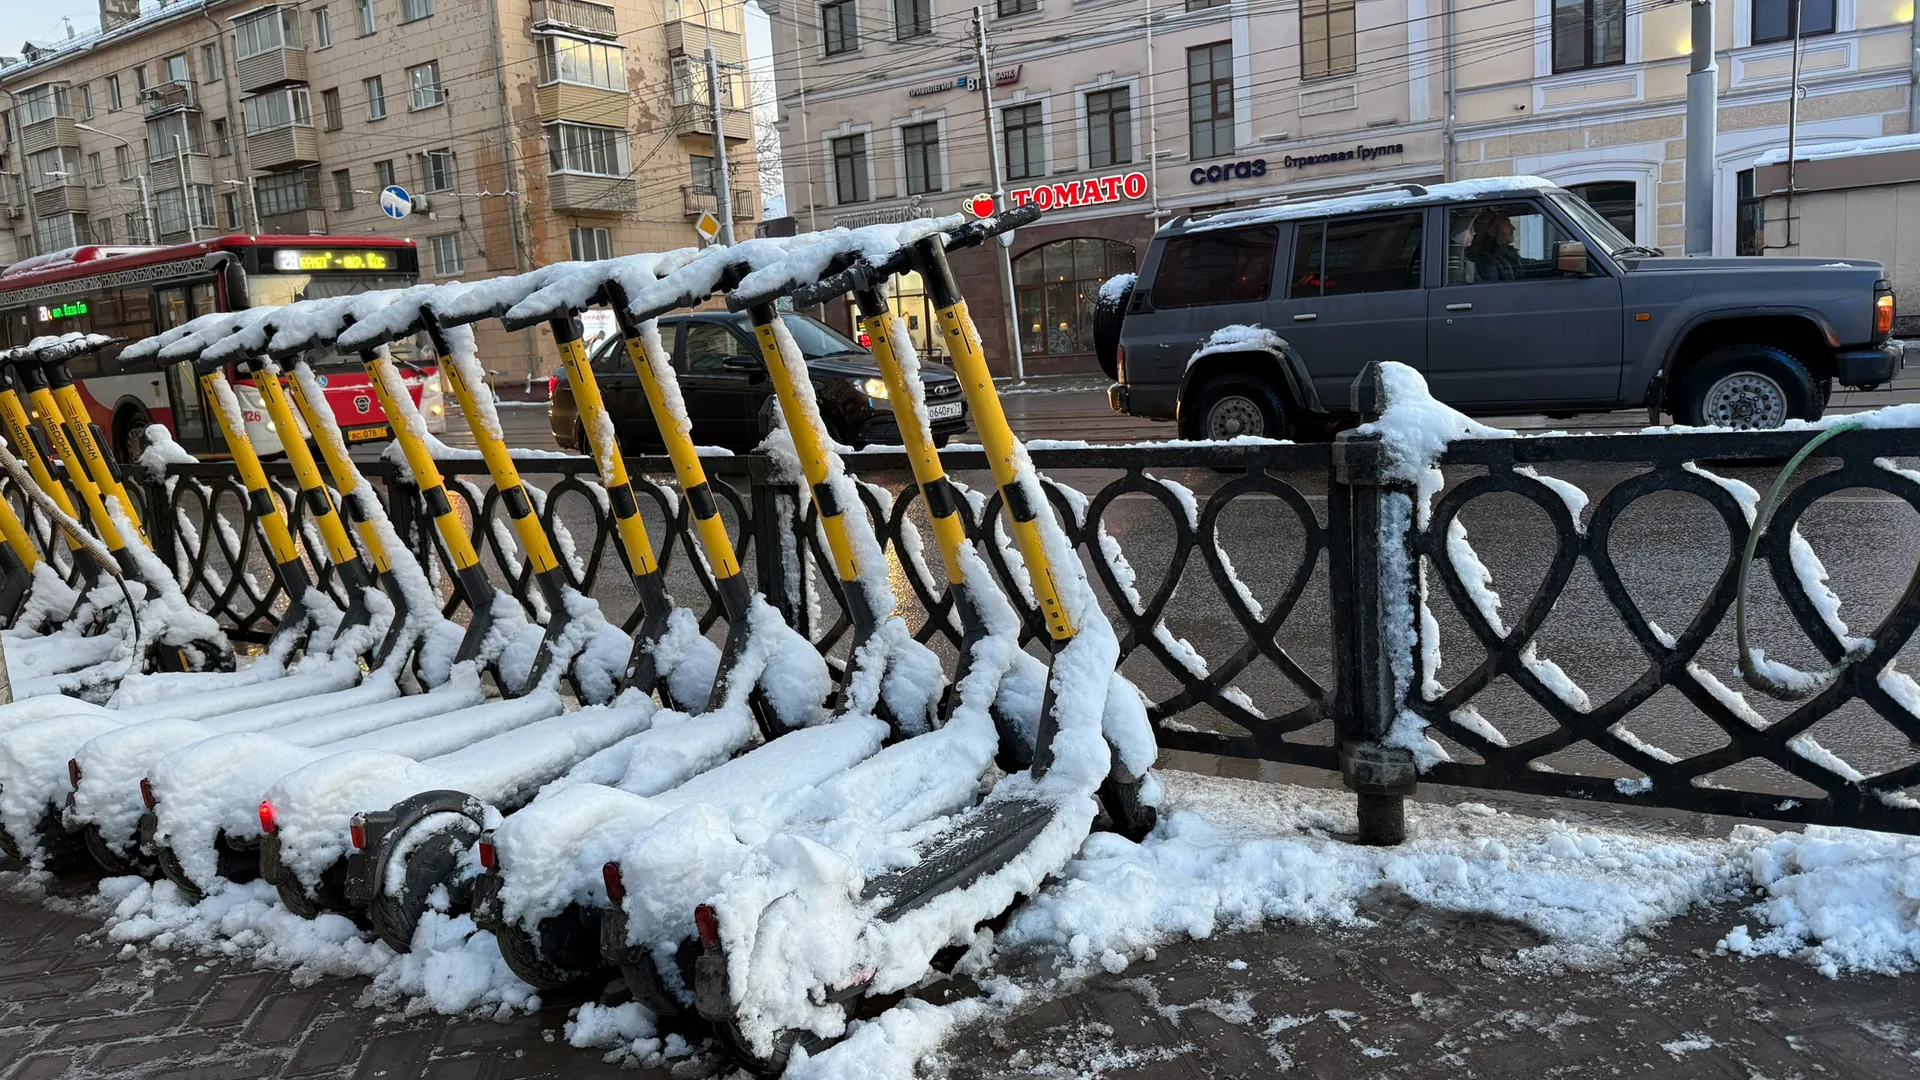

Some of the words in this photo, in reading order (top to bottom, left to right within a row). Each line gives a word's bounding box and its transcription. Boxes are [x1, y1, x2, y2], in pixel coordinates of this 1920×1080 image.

[909, 82, 952, 97] ПРИВИЛЕГИЯ
[967, 77, 982, 92] ВТ
[1284, 150, 1353, 169] Страховая
[1357, 143, 1403, 160] Группа
[1011, 171, 1147, 212] TOMATO
